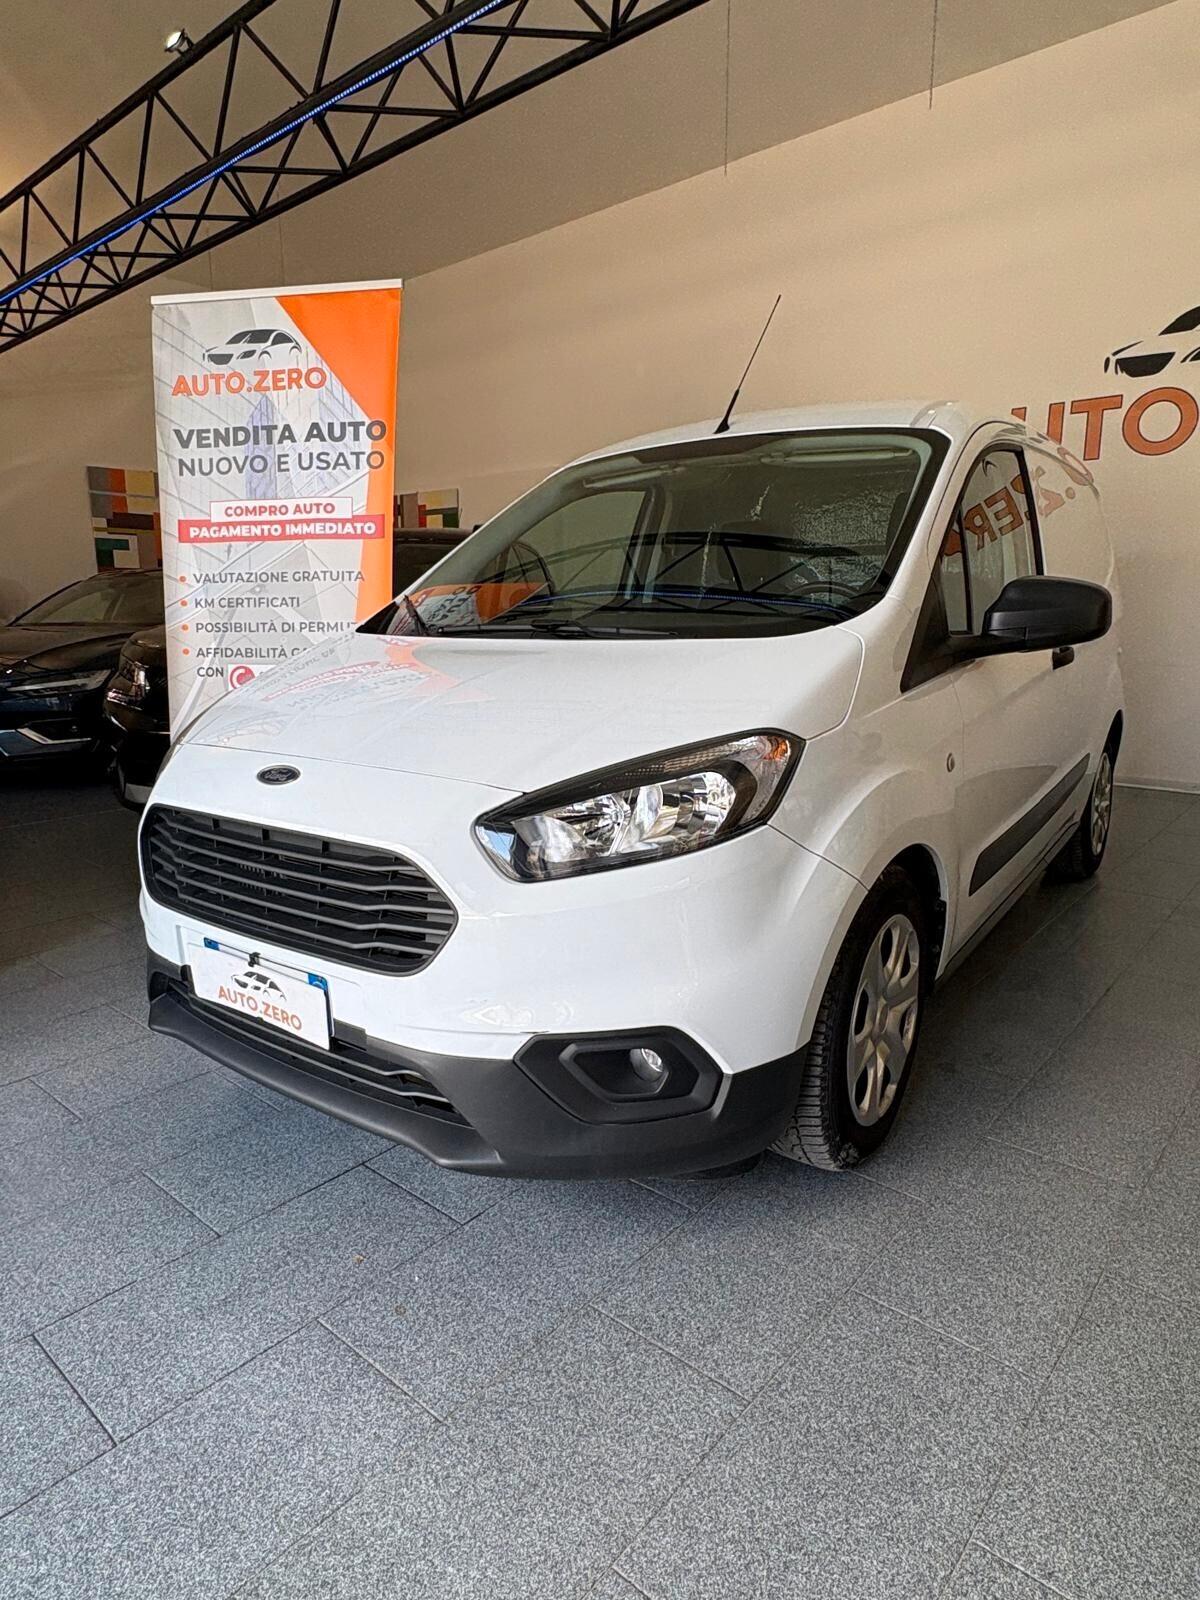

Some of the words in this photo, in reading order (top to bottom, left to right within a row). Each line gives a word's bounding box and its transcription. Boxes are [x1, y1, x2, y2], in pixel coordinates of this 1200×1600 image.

[172, 367, 327, 396] AUTO.ZERO
[173, 424, 297, 449] VENDITA
[304, 420, 387, 443] AUTO
[178, 454, 268, 477] NUOVO
[277, 453, 290, 473] E
[297, 450, 385, 471] USATO
[224, 505, 289, 518] COMPRO
[293, 502, 335, 515] AUTO
[189, 523, 281, 539] PAGAMENTO
[286, 521, 376, 536] IMMEDIATO
[193, 572, 288, 584] VALUTAZIONE
[292, 570, 365, 583] GRATUITA
[194, 598, 215, 609] KM
[218, 597, 300, 609] CERTIFICATI
[195, 619, 276, 633] POSSIBILITÀ
[281, 622, 295, 633] DI
[196, 645, 288, 659] AFFIDABILITÀ
[196, 667, 224, 678] CON
